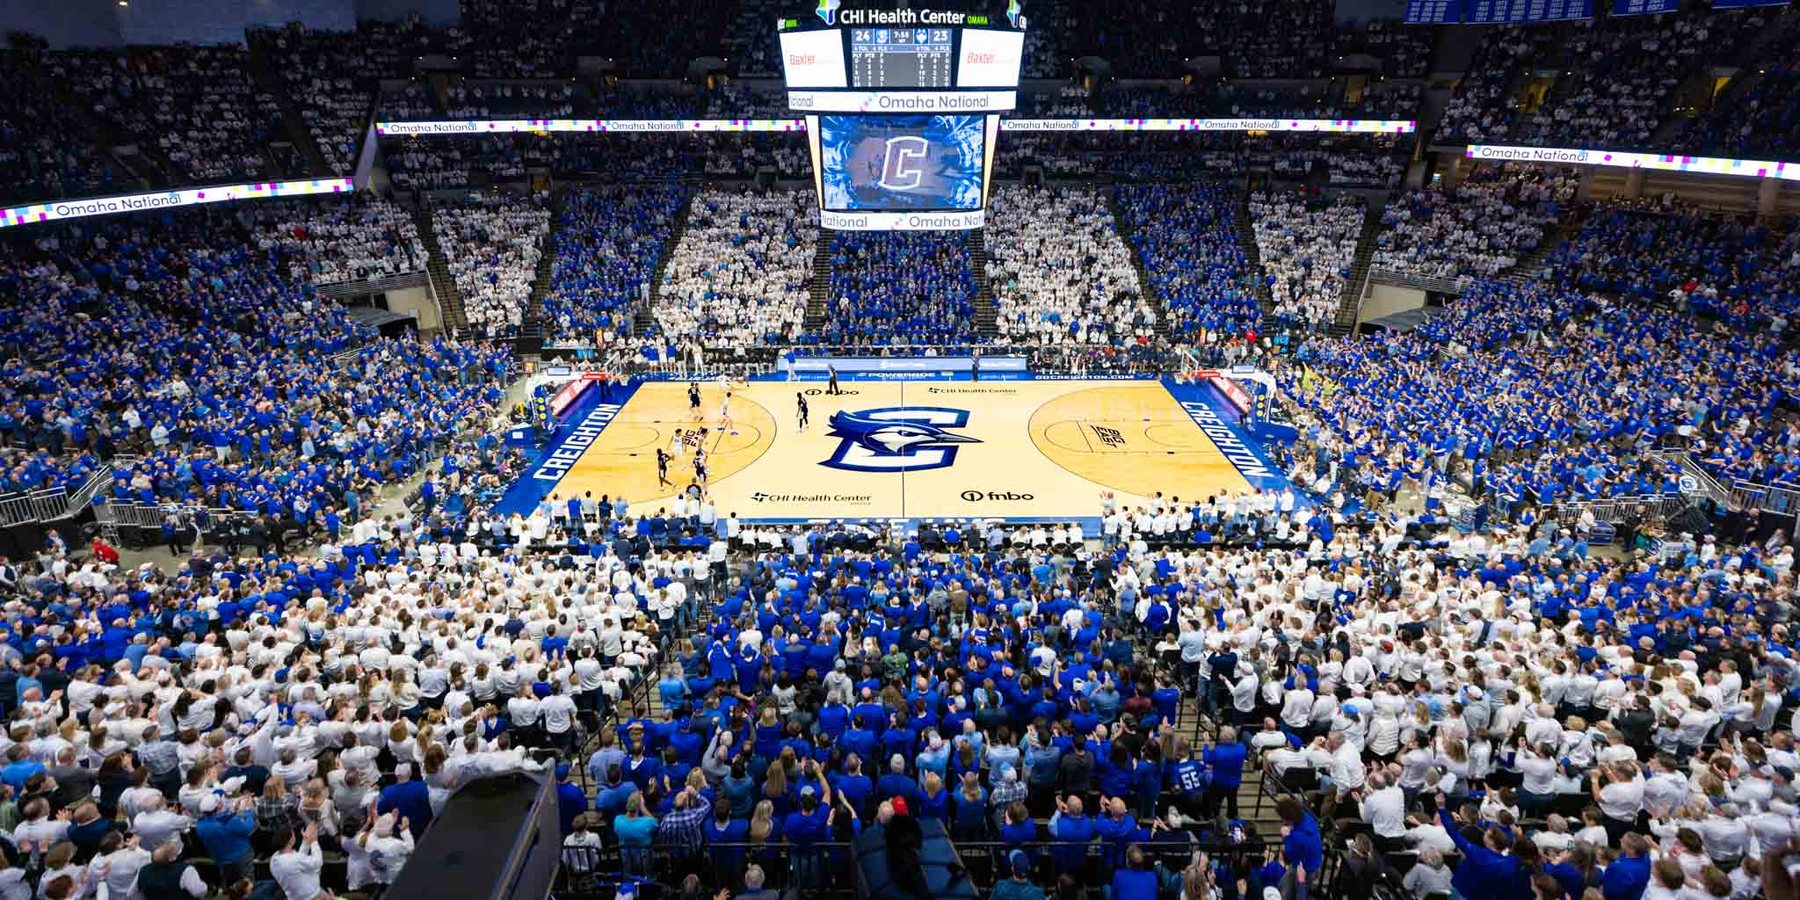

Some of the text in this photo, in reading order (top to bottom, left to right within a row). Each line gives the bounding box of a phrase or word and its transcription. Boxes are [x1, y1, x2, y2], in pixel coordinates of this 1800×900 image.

[840, 8, 988, 25] CHI Health Center OMAHA
[855, 31, 870, 41] 24
[933, 31, 949, 41] 23
[789, 54, 815, 65] Baxter
[967, 53, 994, 64] Baxter
[879, 94, 989, 108] Omaha National
[390, 122, 477, 133] Omaha National
[612, 121, 684, 130] Omaha National
[1008, 121, 1079, 129] Omaha National
[1204, 120, 1280, 129] Omaha National
[1482, 147, 1588, 161] Omaha National
[56, 194, 182, 216] Omaha National
[909, 215, 960, 228] Omaha
[533, 403, 622, 480] CREIGHTON
[1180, 401, 1275, 477] CREIGHTON
[768, 494, 871, 502] CHI Health Center
[987, 491, 1034, 500] fnbo
[1180, 771, 1201, 790] 55
